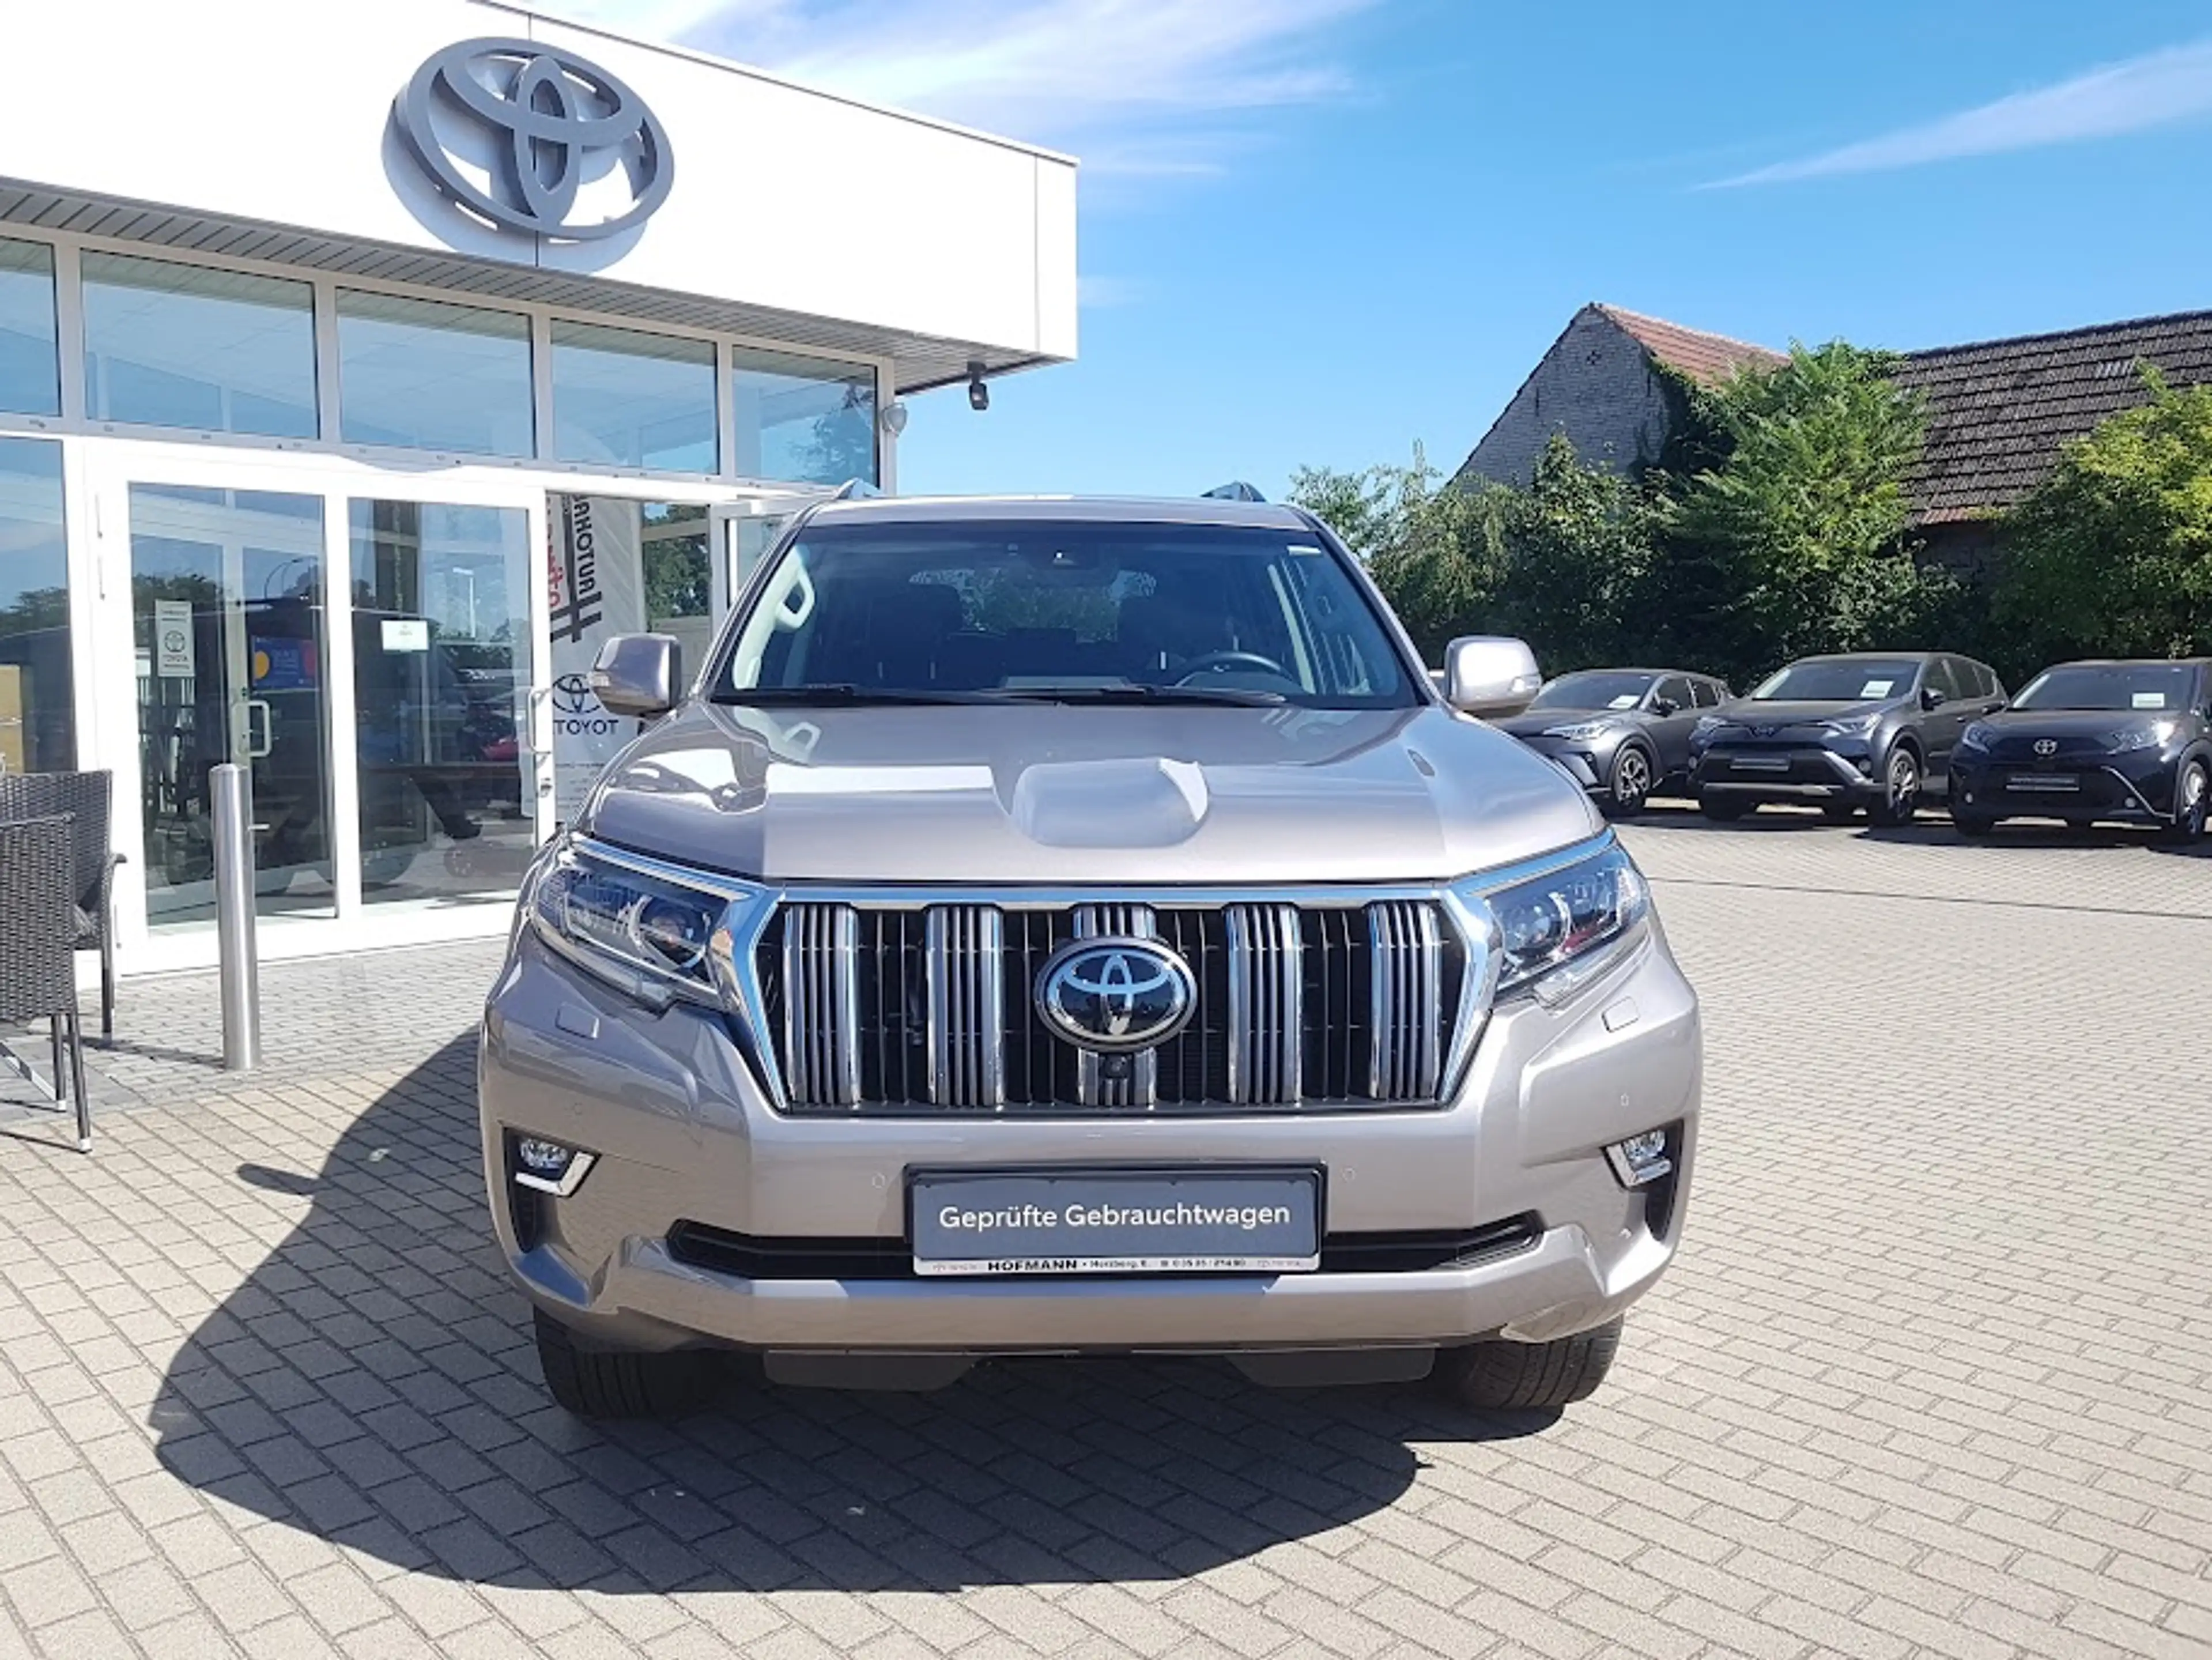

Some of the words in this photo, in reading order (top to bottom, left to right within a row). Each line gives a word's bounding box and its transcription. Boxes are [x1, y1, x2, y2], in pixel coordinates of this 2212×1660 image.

[939, 1204, 1058, 1233] Geprüfte
[1065, 1202, 1291, 1230] Gebrauchtwagen
[988, 1260, 1077, 1272] HOFMANN
